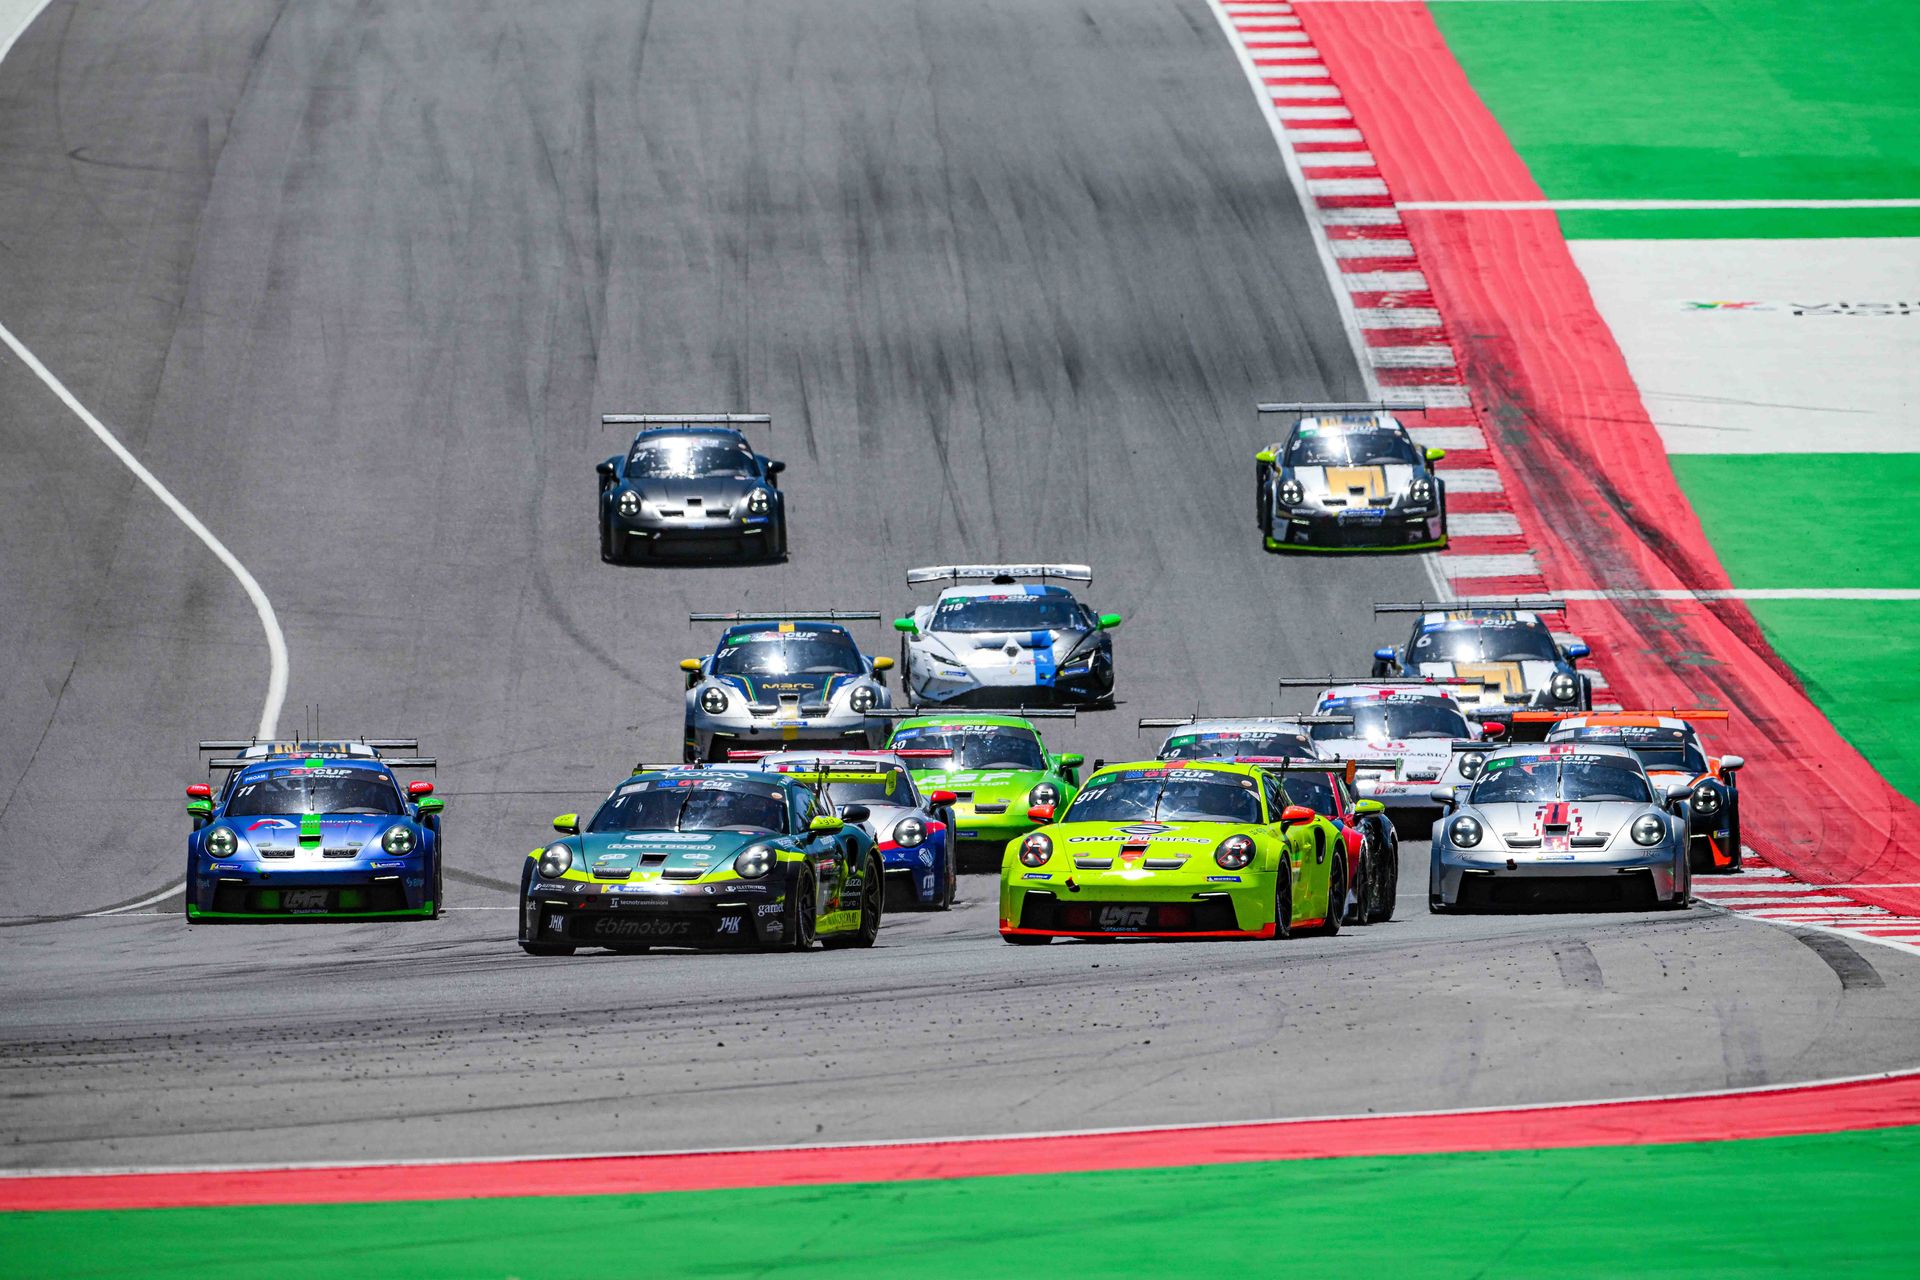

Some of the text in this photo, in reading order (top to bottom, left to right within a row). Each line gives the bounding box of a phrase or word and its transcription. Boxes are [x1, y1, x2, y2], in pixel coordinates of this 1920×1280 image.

[1416, 634, 1432, 648] 6
[238, 785, 256, 797] 11
[1074, 788, 1107, 805] 911
[717, 916, 742, 933] JHK
[1100, 906, 1150, 926] LMR
